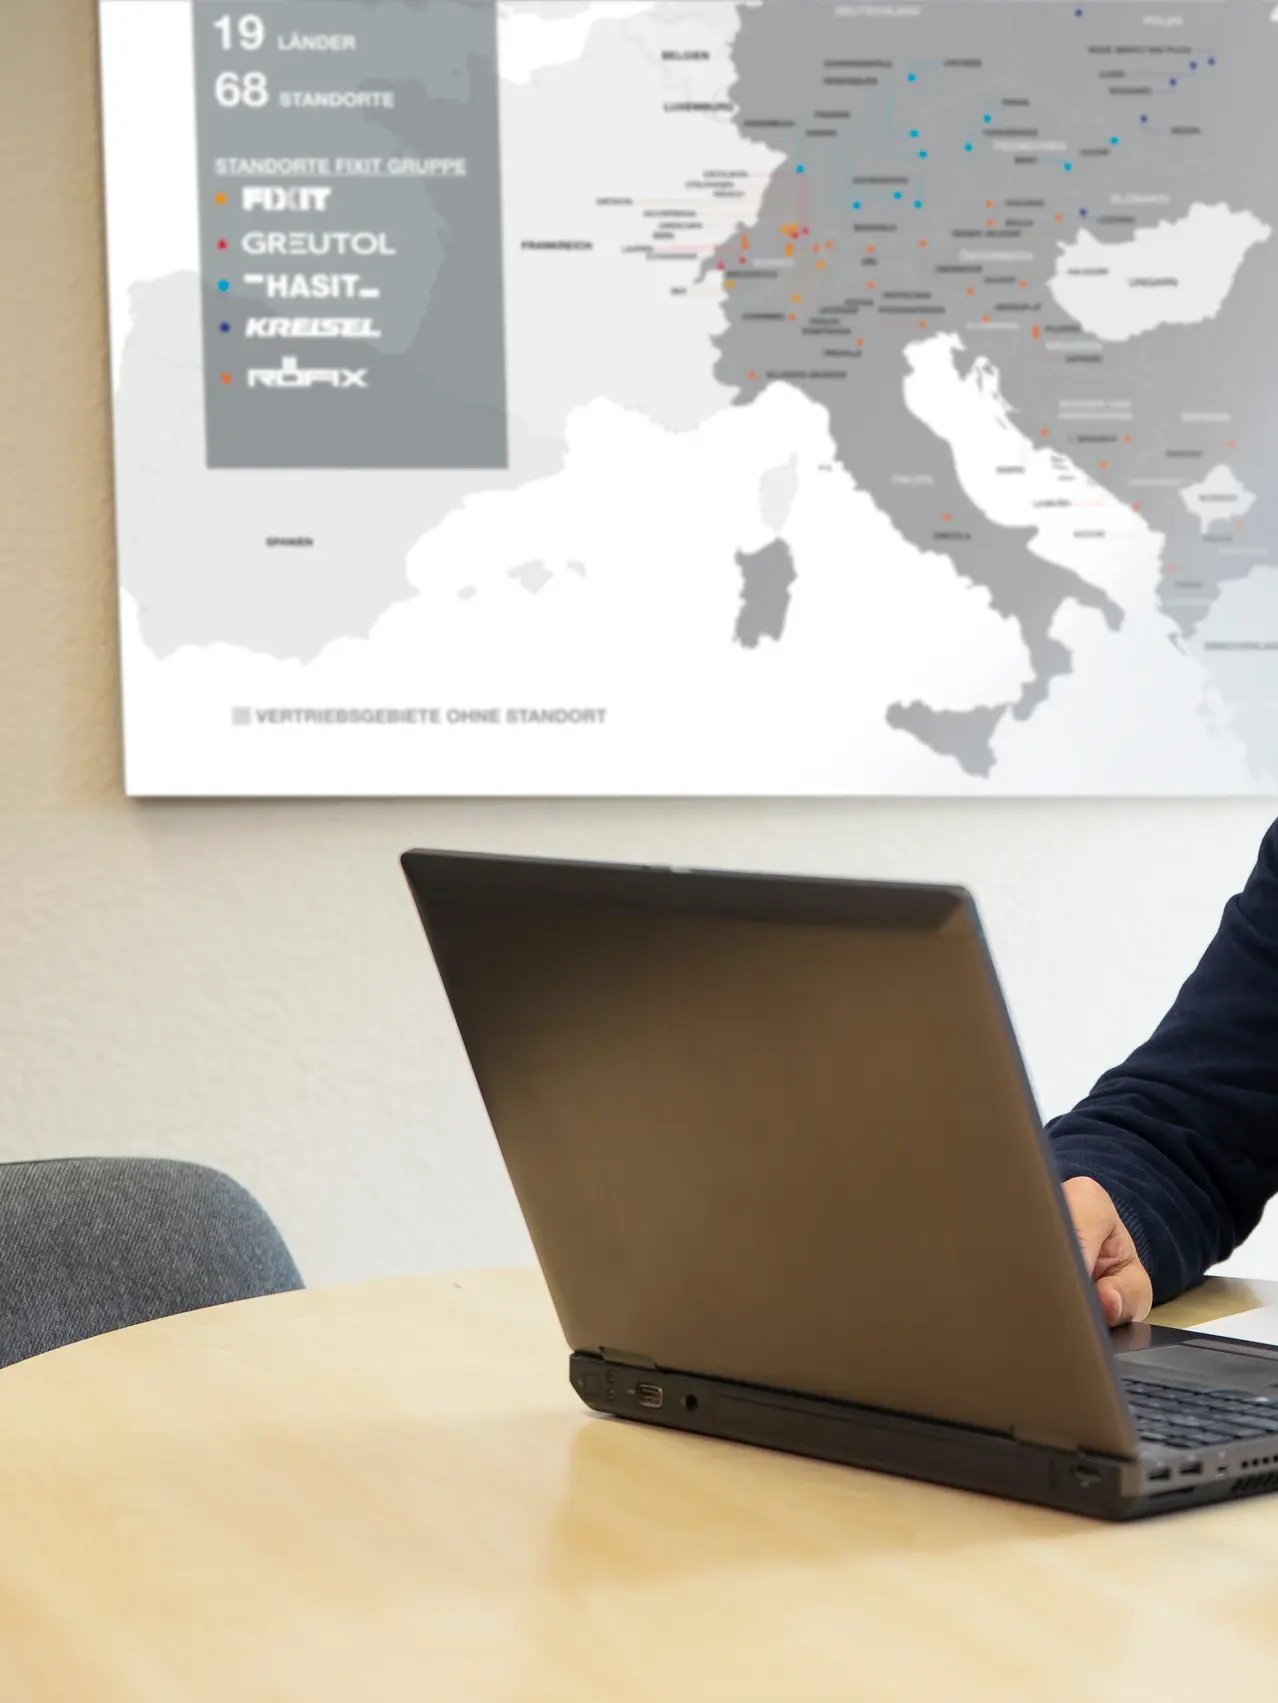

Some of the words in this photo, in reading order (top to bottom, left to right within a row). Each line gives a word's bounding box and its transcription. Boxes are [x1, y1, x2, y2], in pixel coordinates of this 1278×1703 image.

[213, 13, 265, 51] 19
[277, 31, 357, 51] LÄNDER
[214, 71, 269, 108] 68
[279, 91, 394, 108] STANDORTE
[215, 157, 330, 176] STANDORTE
[335, 157, 381, 175] FIXIT
[386, 157, 467, 176] GRUPPE
[242, 186, 332, 212] FIXIT
[241, 231, 397, 256] GREUTOL
[266, 273, 360, 299] HASIT
[244, 316, 381, 339] KREISEL
[247, 355, 368, 388] RÖFIX
[255, 707, 441, 725] VERTRIEBSGEBIETE
[445, 707, 501, 725] OHNE
[505, 707, 607, 725] STANDORT
